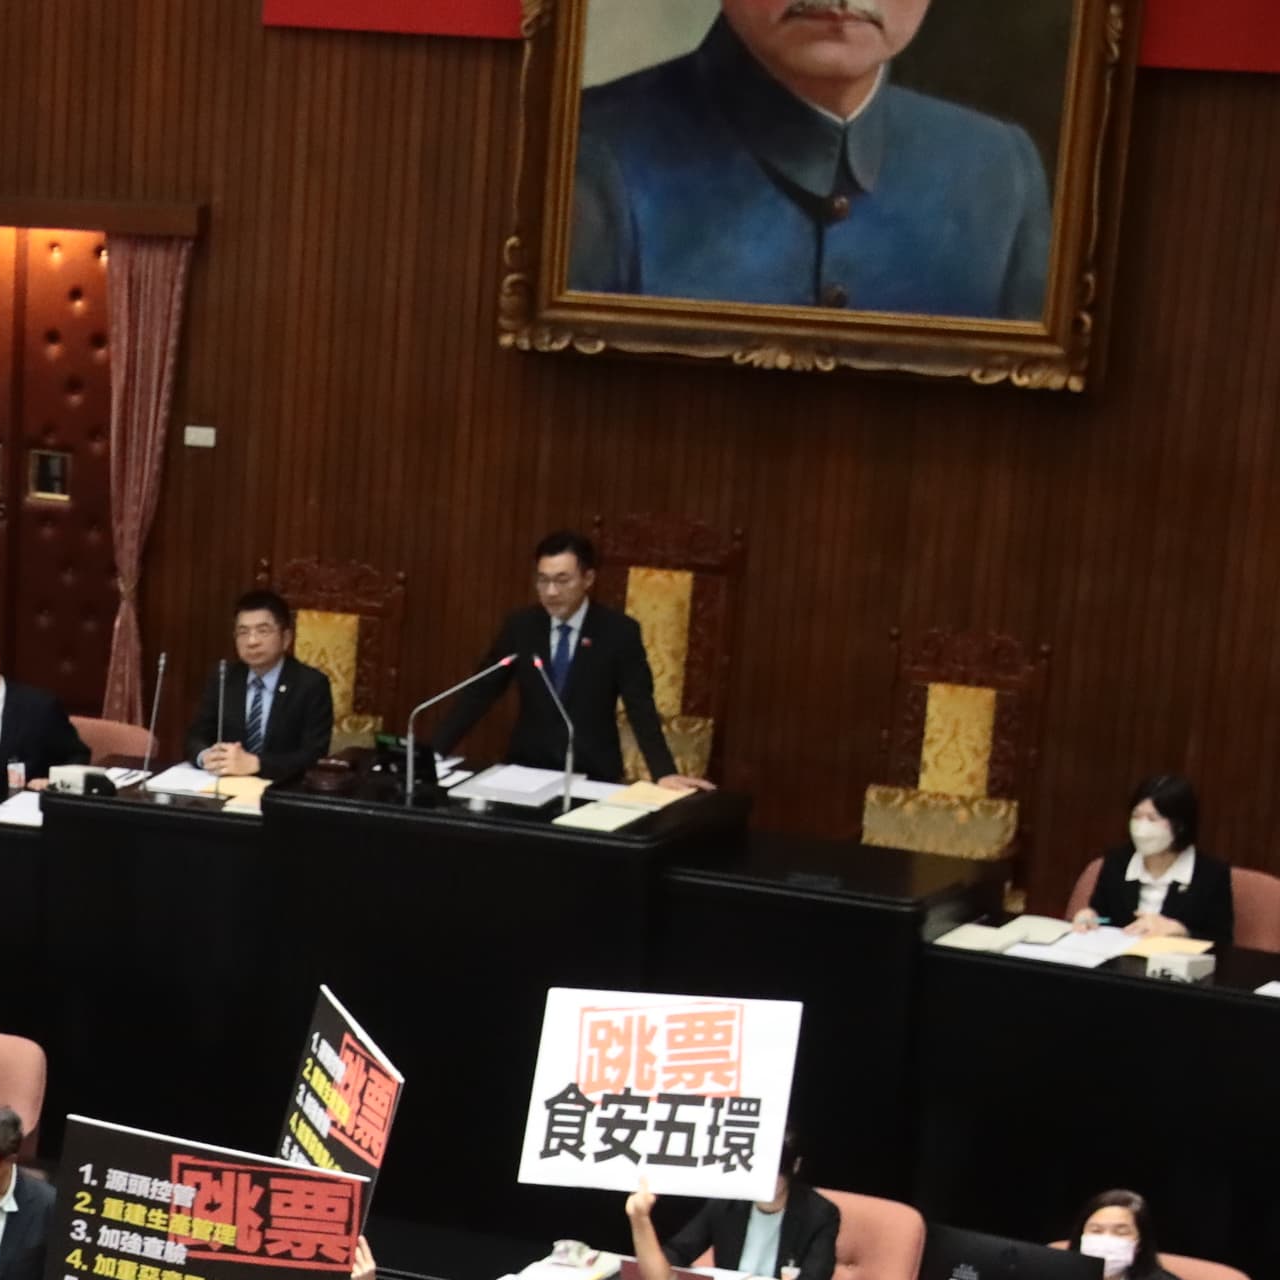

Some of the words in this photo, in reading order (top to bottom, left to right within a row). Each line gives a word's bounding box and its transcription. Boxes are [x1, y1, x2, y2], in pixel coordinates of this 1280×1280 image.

[582, 1010, 737, 1094] 跳票
[539, 1082, 762, 1173] 食安五環
[105, 1168, 197, 1208] 源頭控管
[182, 1168, 352, 1264] 跳票
[98, 1225, 188, 1265] 加強查驗
[101, 1197, 238, 1247] 重建生產管理
